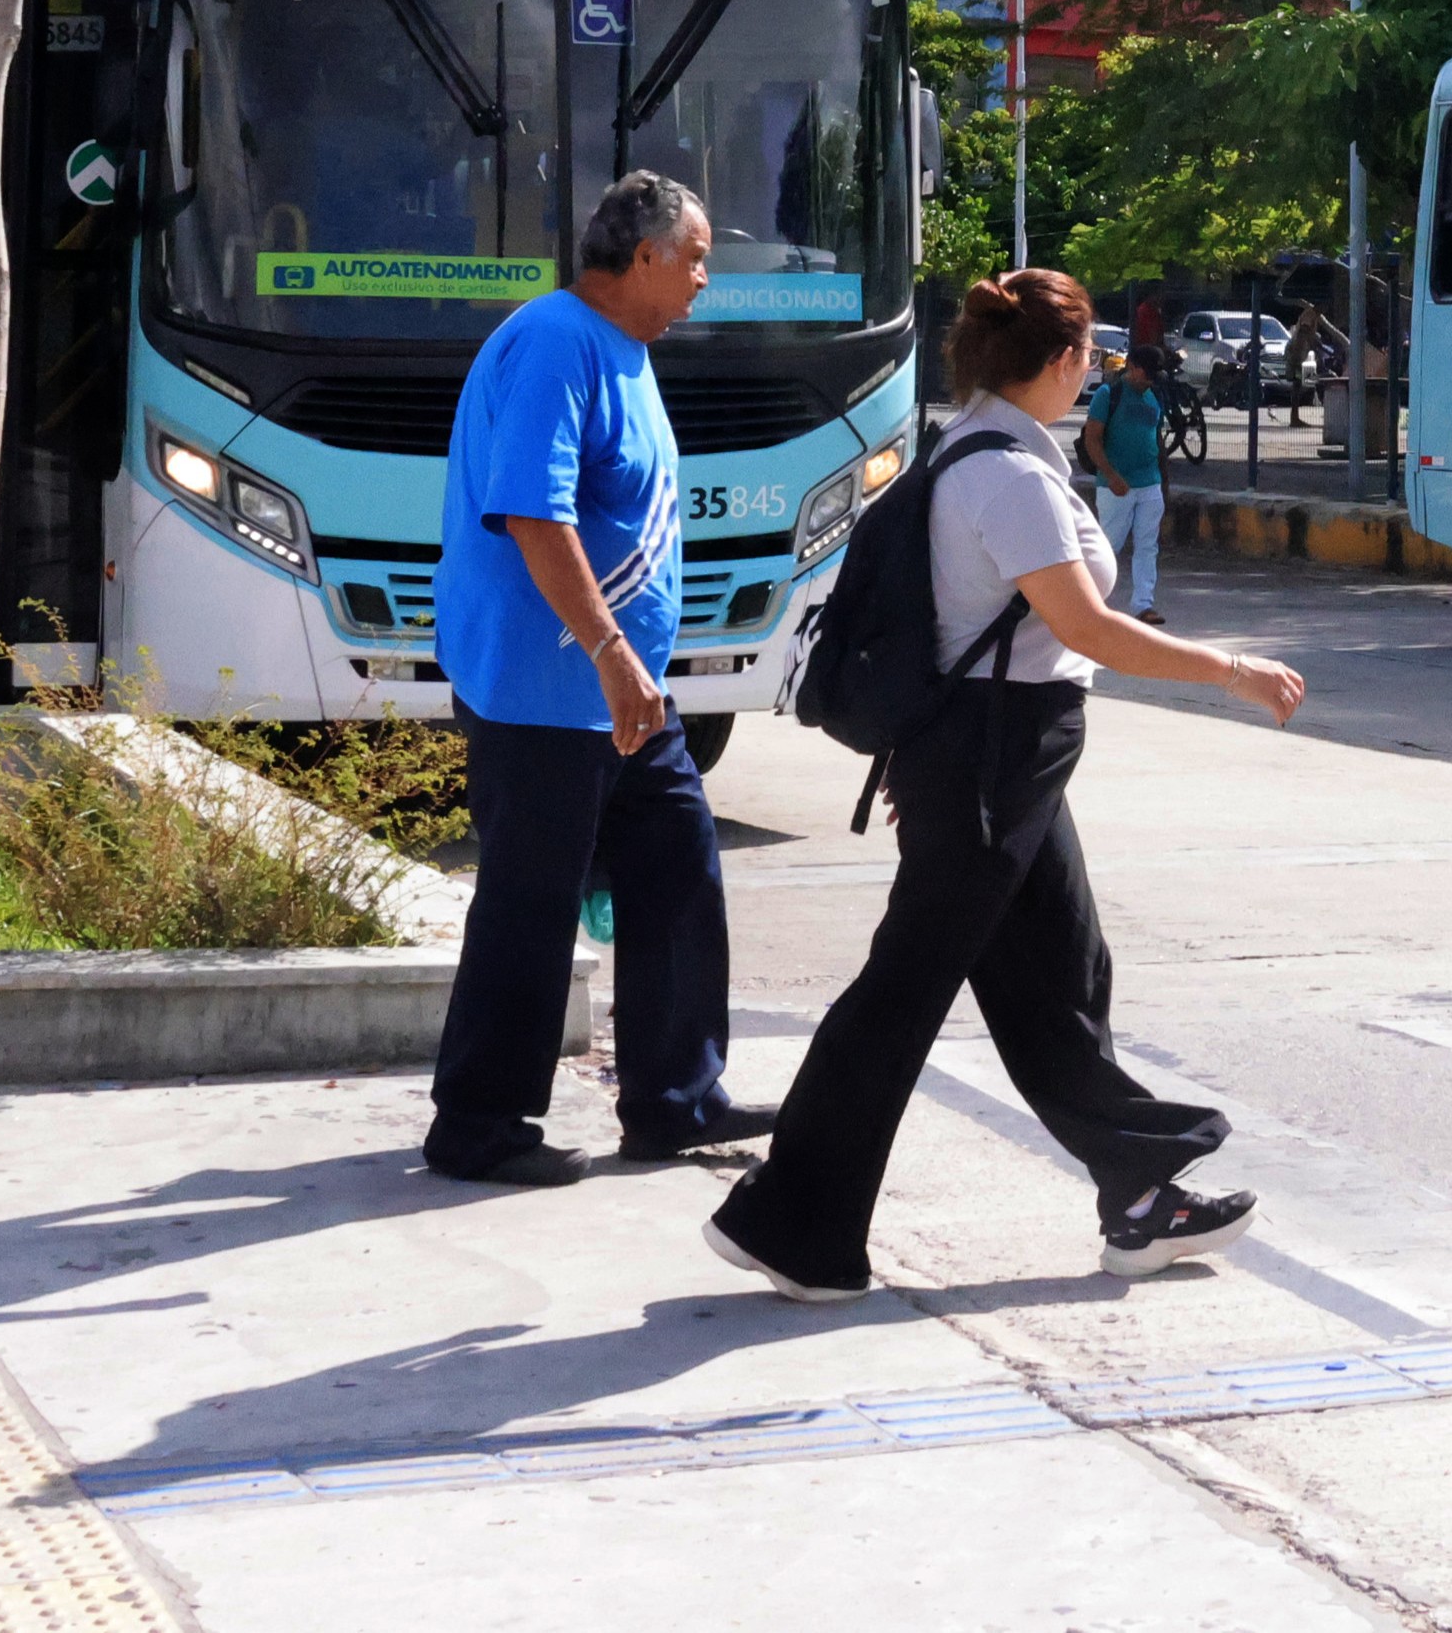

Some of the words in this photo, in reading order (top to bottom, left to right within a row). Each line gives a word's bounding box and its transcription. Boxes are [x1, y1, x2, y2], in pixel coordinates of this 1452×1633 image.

[323, 259, 542, 283] AUTOATENDIMENTO
[342, 280, 368, 292] Uso
[371, 281, 434, 293] exclusivo
[438, 281, 455, 294] de
[692, 288, 857, 311] ONDICIONADO
[687, 484, 788, 520] 35845
